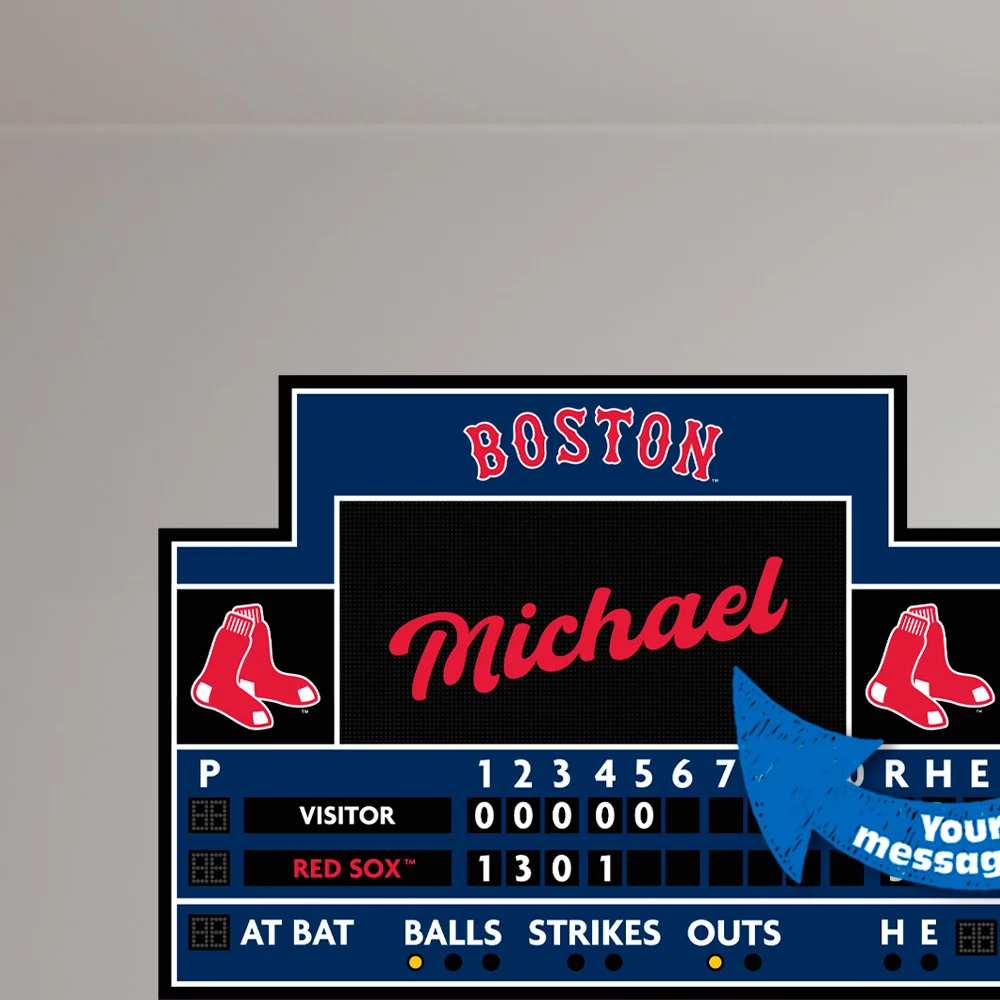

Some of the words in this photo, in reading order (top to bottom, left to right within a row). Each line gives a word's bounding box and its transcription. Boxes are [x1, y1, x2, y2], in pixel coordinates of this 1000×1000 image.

[463, 406, 724, 482] BOSTON
[389, 556, 788, 701] Michael
[201, 759, 220, 788] P
[479, 759, 490, 788] 1
[514, 759, 532, 788] 2
[554, 759, 570, 788] 3
[595, 759, 616, 788] 4
[636, 759, 652, 788] 5
[673, 759, 692, 788] 6
[716, 759, 736, 788] 7
[886, 759, 909, 788] R
[927, 759, 951, 788] H
[972, 759, 988, 788] E
[300, 806, 396, 825] VISITOR
[475, 802, 494, 829] 0
[514, 802, 533, 829] 0
[553, 802, 571, 829] 0
[596, 802, 614, 829] 0
[635, 802, 653, 829] 0
[294, 859, 341, 878] RED
[479, 855, 490, 881] 1
[516, 855, 532, 882] 3
[553, 855, 571, 882] 0
[600, 855, 611, 881] 1
[241, 920, 282, 945] AT
[294, 920, 354, 945] BAT
[405, 919, 501, 946] BALLS
[529, 919, 660, 946] STRIKES
[687, 919, 781, 946] OUTS
[882, 920, 903, 945] H
[922, 920, 937, 945] E
